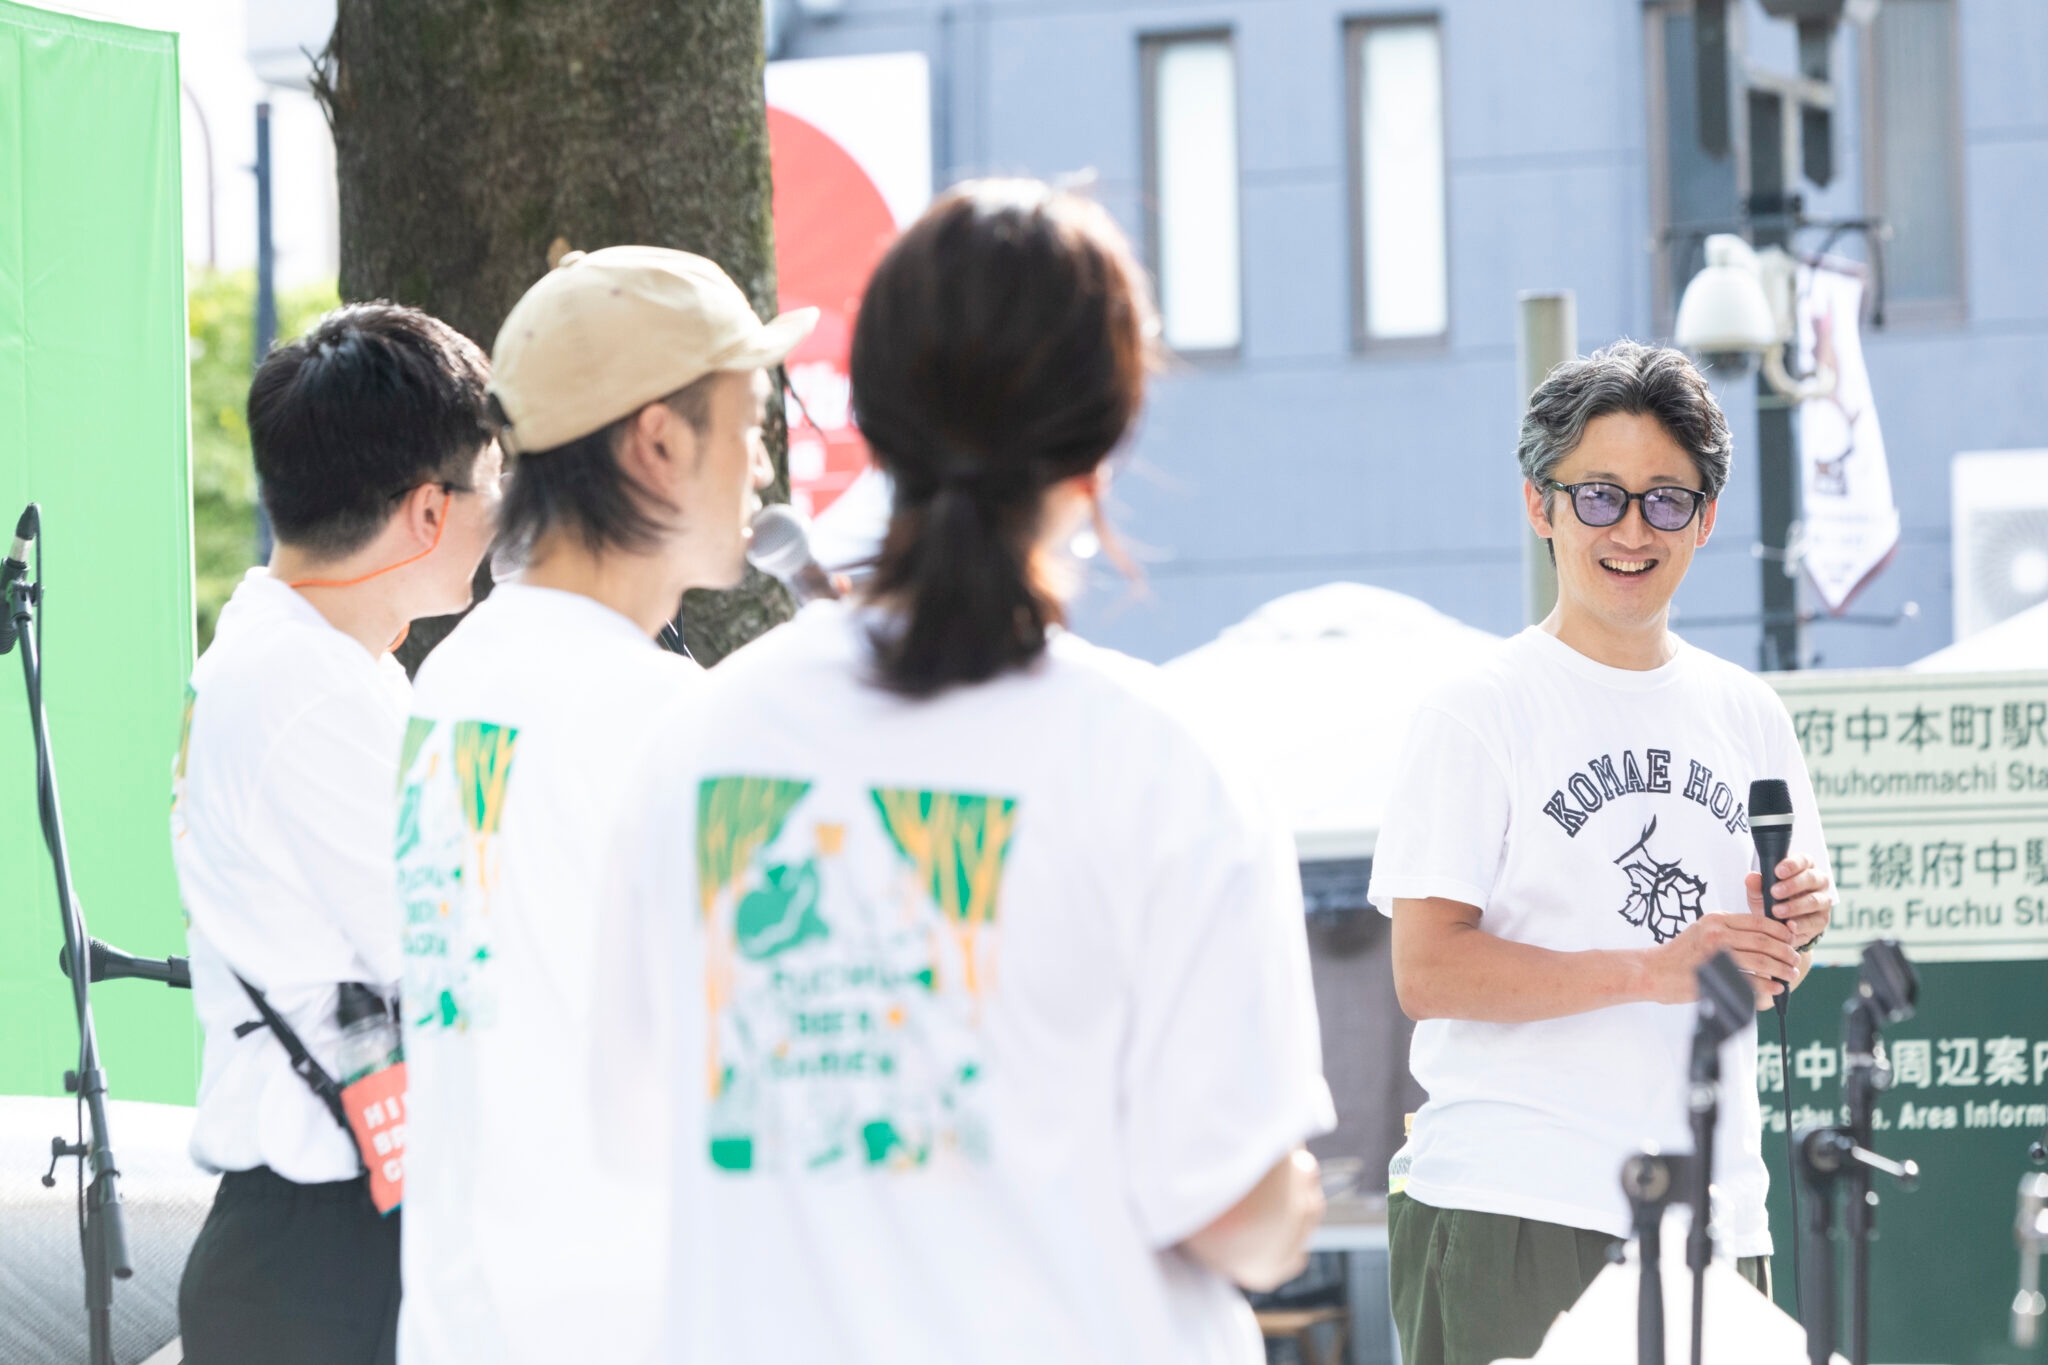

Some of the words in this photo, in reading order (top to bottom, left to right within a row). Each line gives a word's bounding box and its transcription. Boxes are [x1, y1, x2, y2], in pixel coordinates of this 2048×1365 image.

[1542, 748, 1672, 838] KOMAE
[1828, 902, 1896, 931] Line
[1906, 897, 2003, 928] Fuchu
[2015, 895, 2048, 926] St
[1757, 1036, 2048, 1091] 府中周辺案
[363, 1094, 406, 1131] HI
[1841, 1103, 1891, 1131] Sa.
[1897, 1102, 1958, 1131] Area
[1964, 1098, 2048, 1128] Inform
